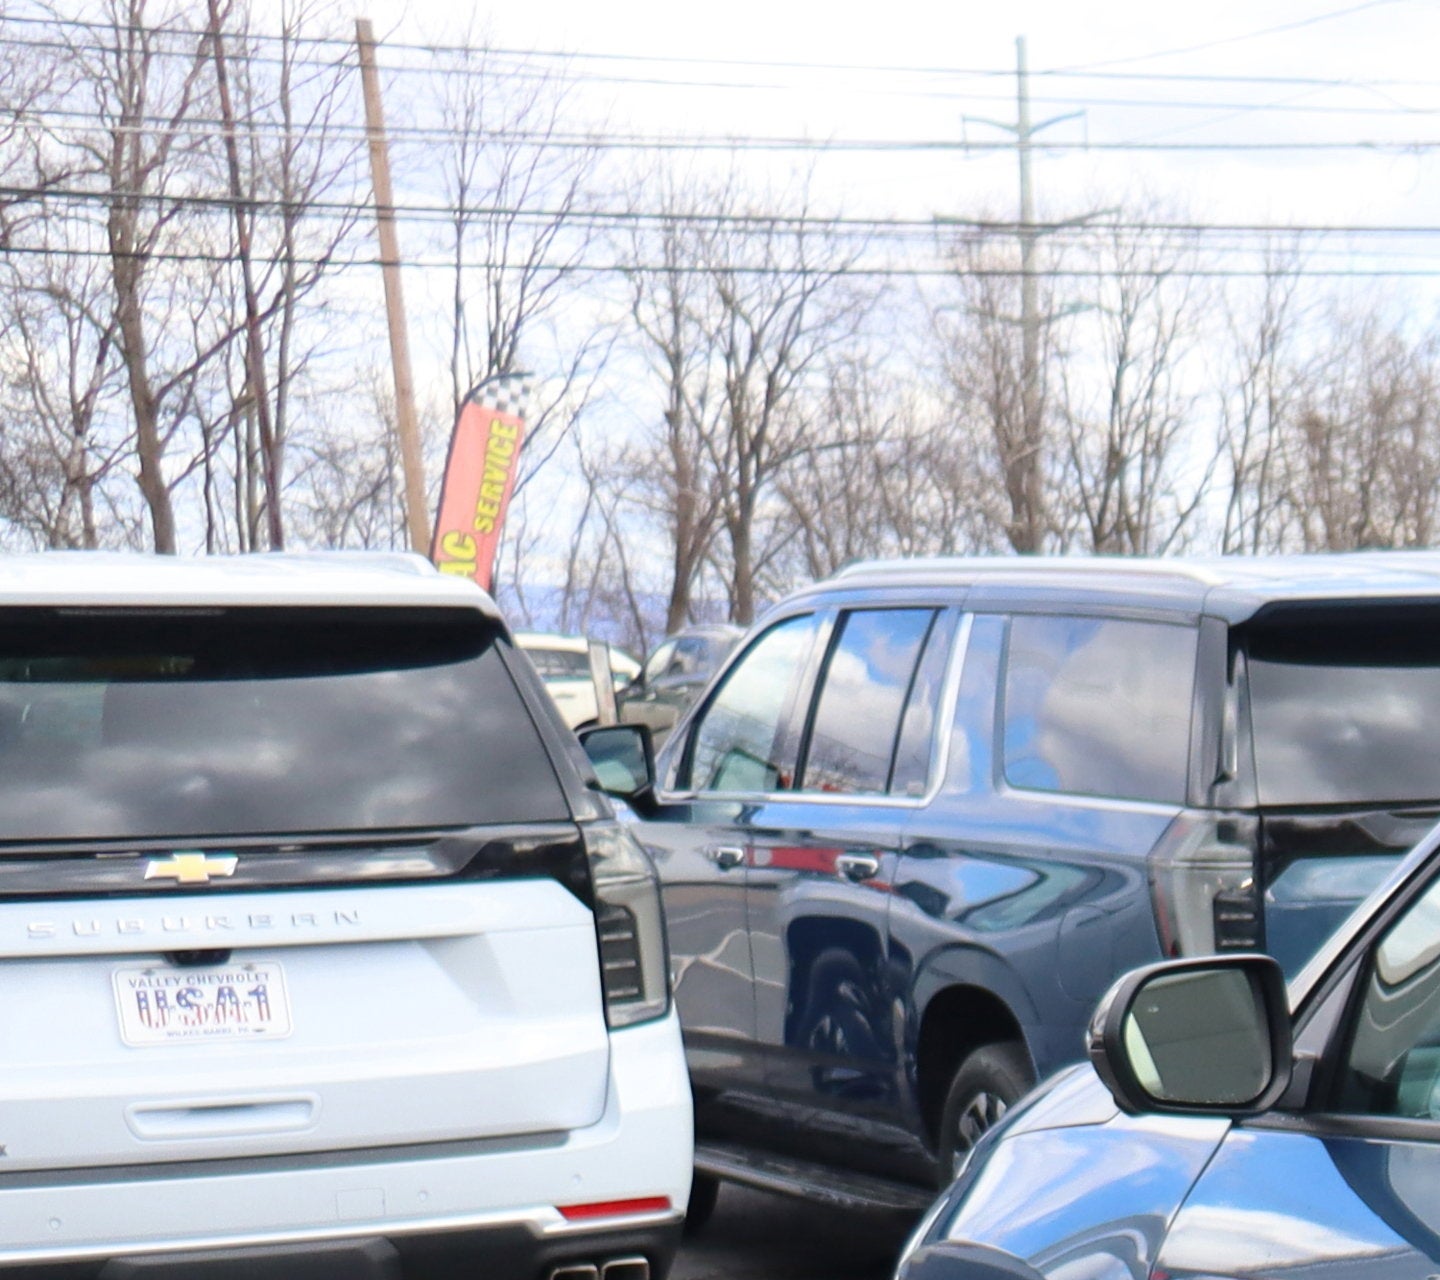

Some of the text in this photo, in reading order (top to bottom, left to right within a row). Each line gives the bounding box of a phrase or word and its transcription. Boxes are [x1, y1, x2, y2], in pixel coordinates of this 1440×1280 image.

[474, 419, 518, 535] SERVICE
[27, 910, 361, 939] SUBURBAN
[128, 972, 270, 988] VALLEY CHEVROLET
